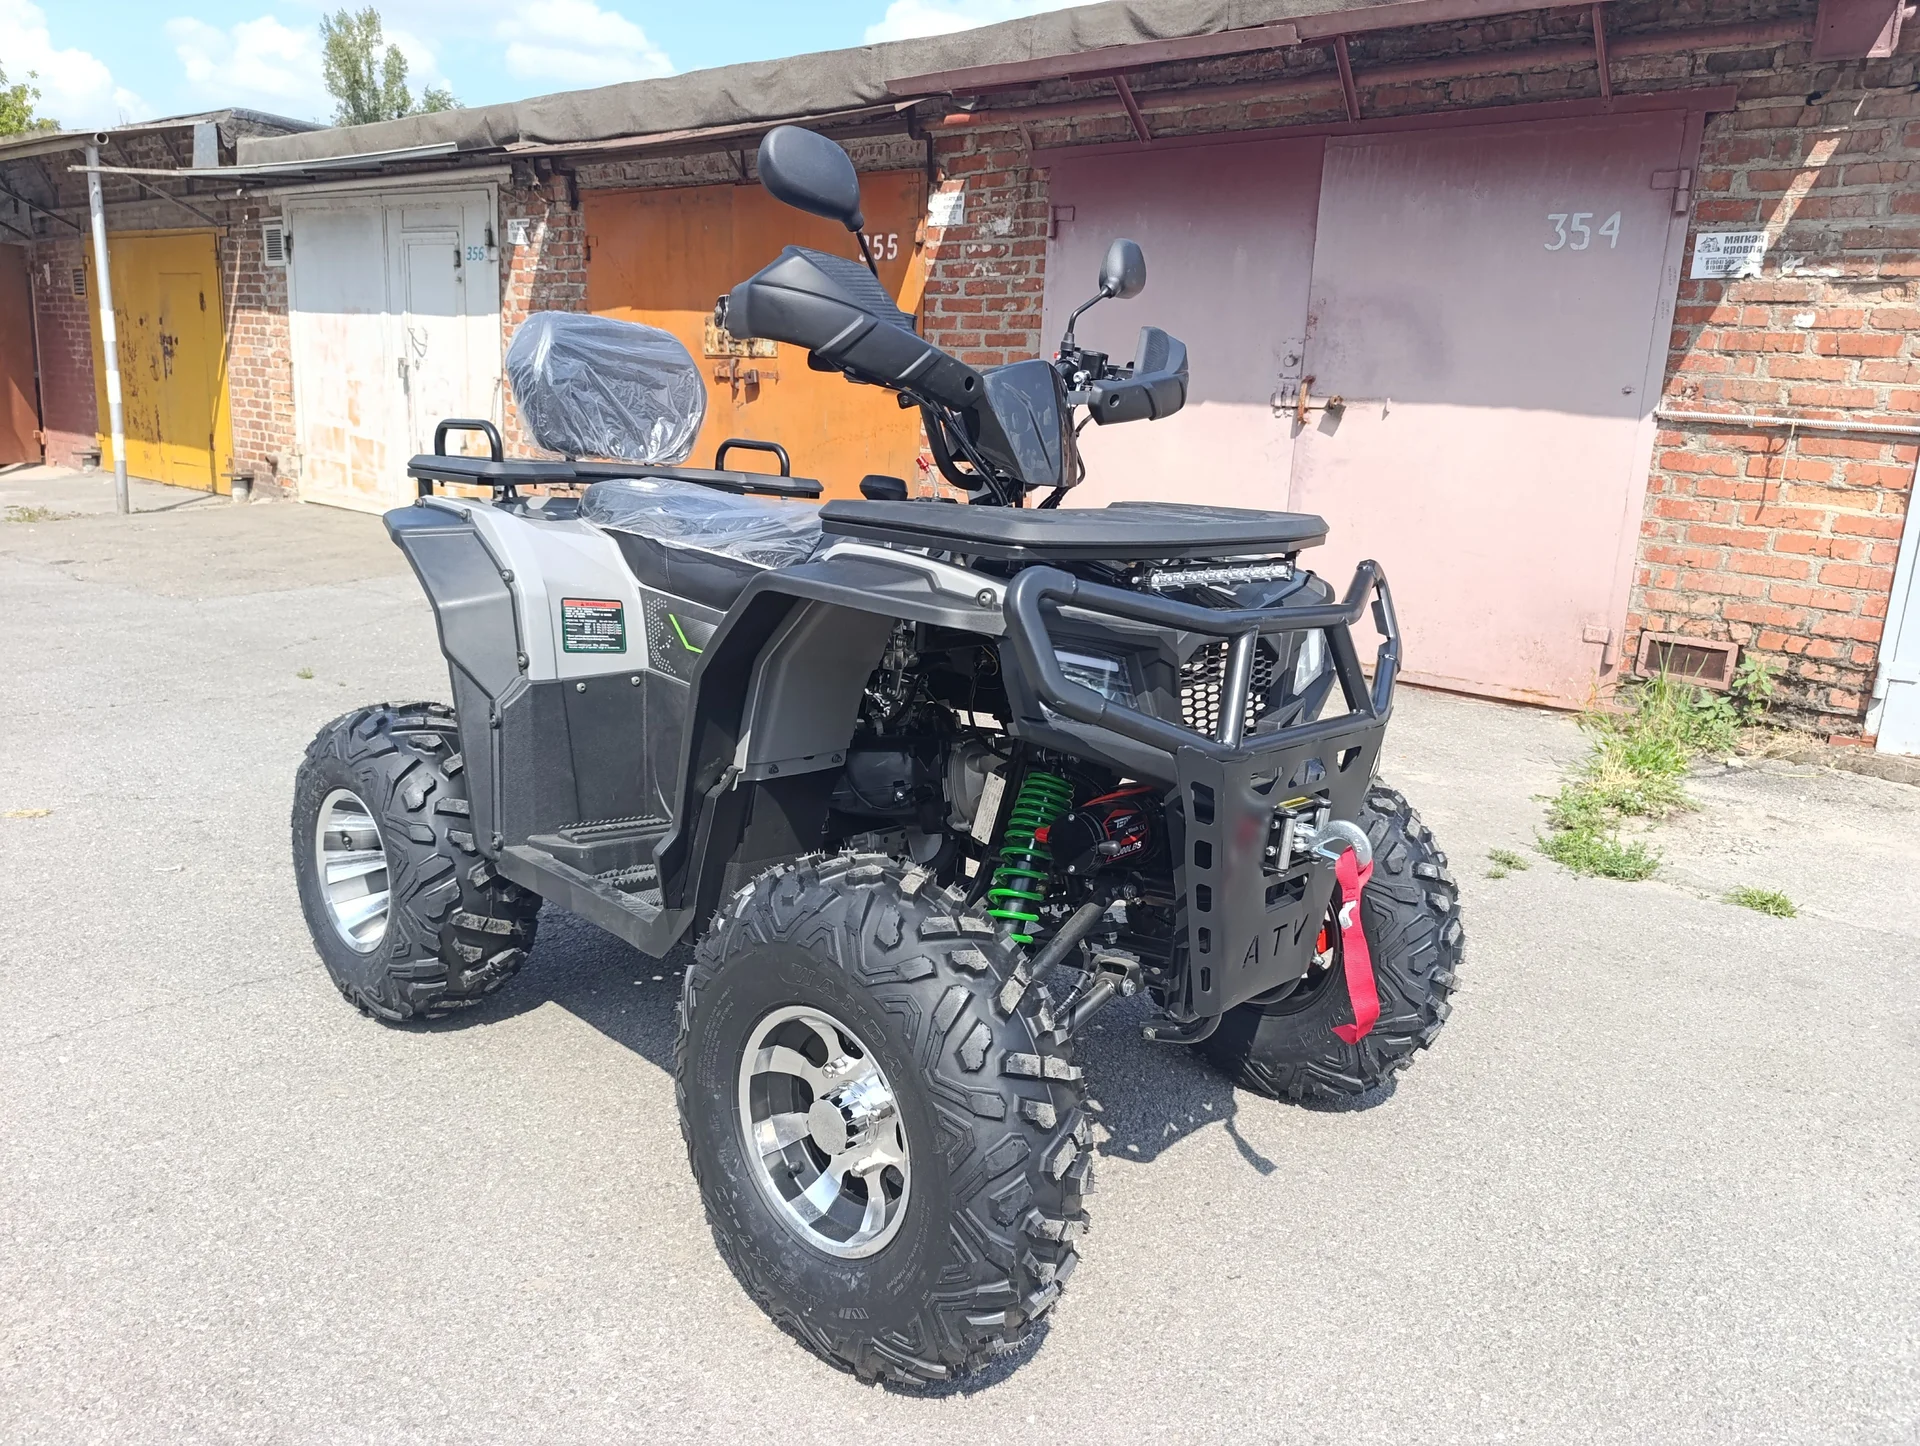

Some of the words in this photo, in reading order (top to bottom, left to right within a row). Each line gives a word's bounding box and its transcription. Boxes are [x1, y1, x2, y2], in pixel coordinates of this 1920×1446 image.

[466, 246, 485, 261] 356
[1543, 211, 1621, 250] 354
[1242, 913, 1309, 969] ATV
[791, 962, 904, 1082] WANDA
